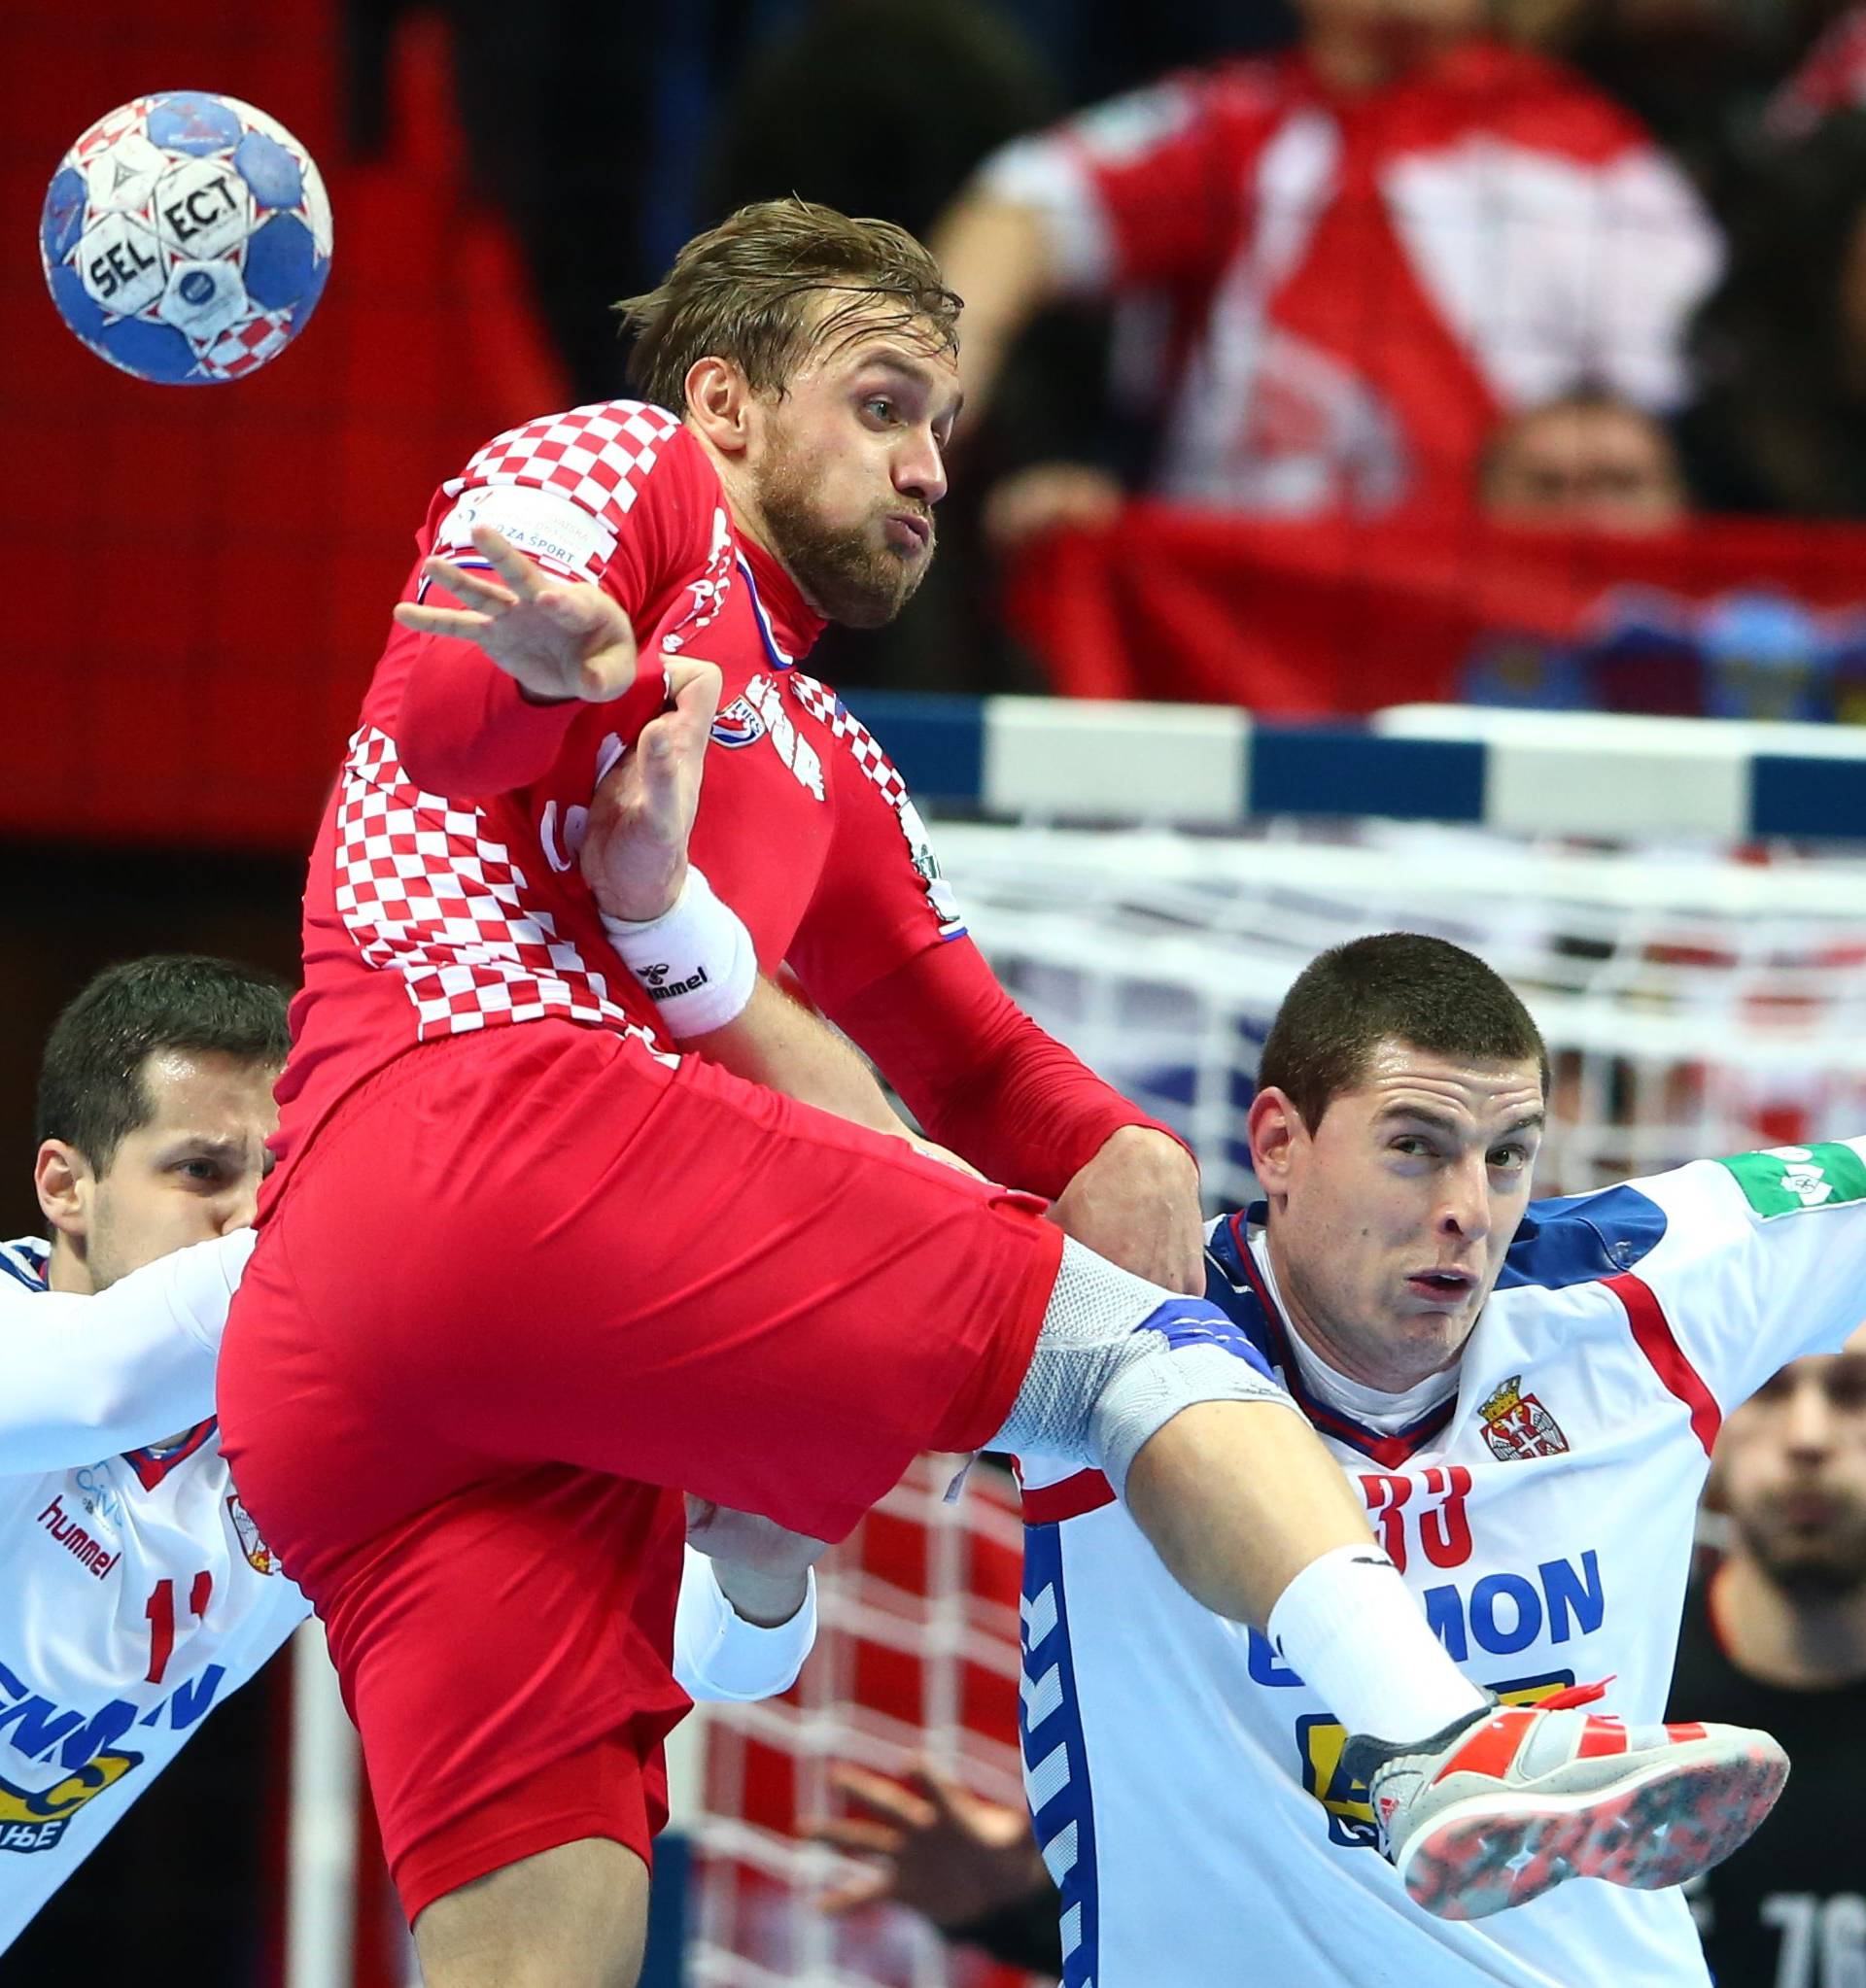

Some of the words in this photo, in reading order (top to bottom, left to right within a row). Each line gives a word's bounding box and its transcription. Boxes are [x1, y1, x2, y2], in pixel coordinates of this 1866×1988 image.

[163, 176, 237, 242] ECT
[89, 238, 156, 297] SEL
[506, 527, 525, 542] ZA
[529, 531, 575, 563] ŠPORT
[646, 966, 708, 1000] mmel
[37, 1493, 121, 1581] hummel
[1358, 1465, 1473, 1576] 33
